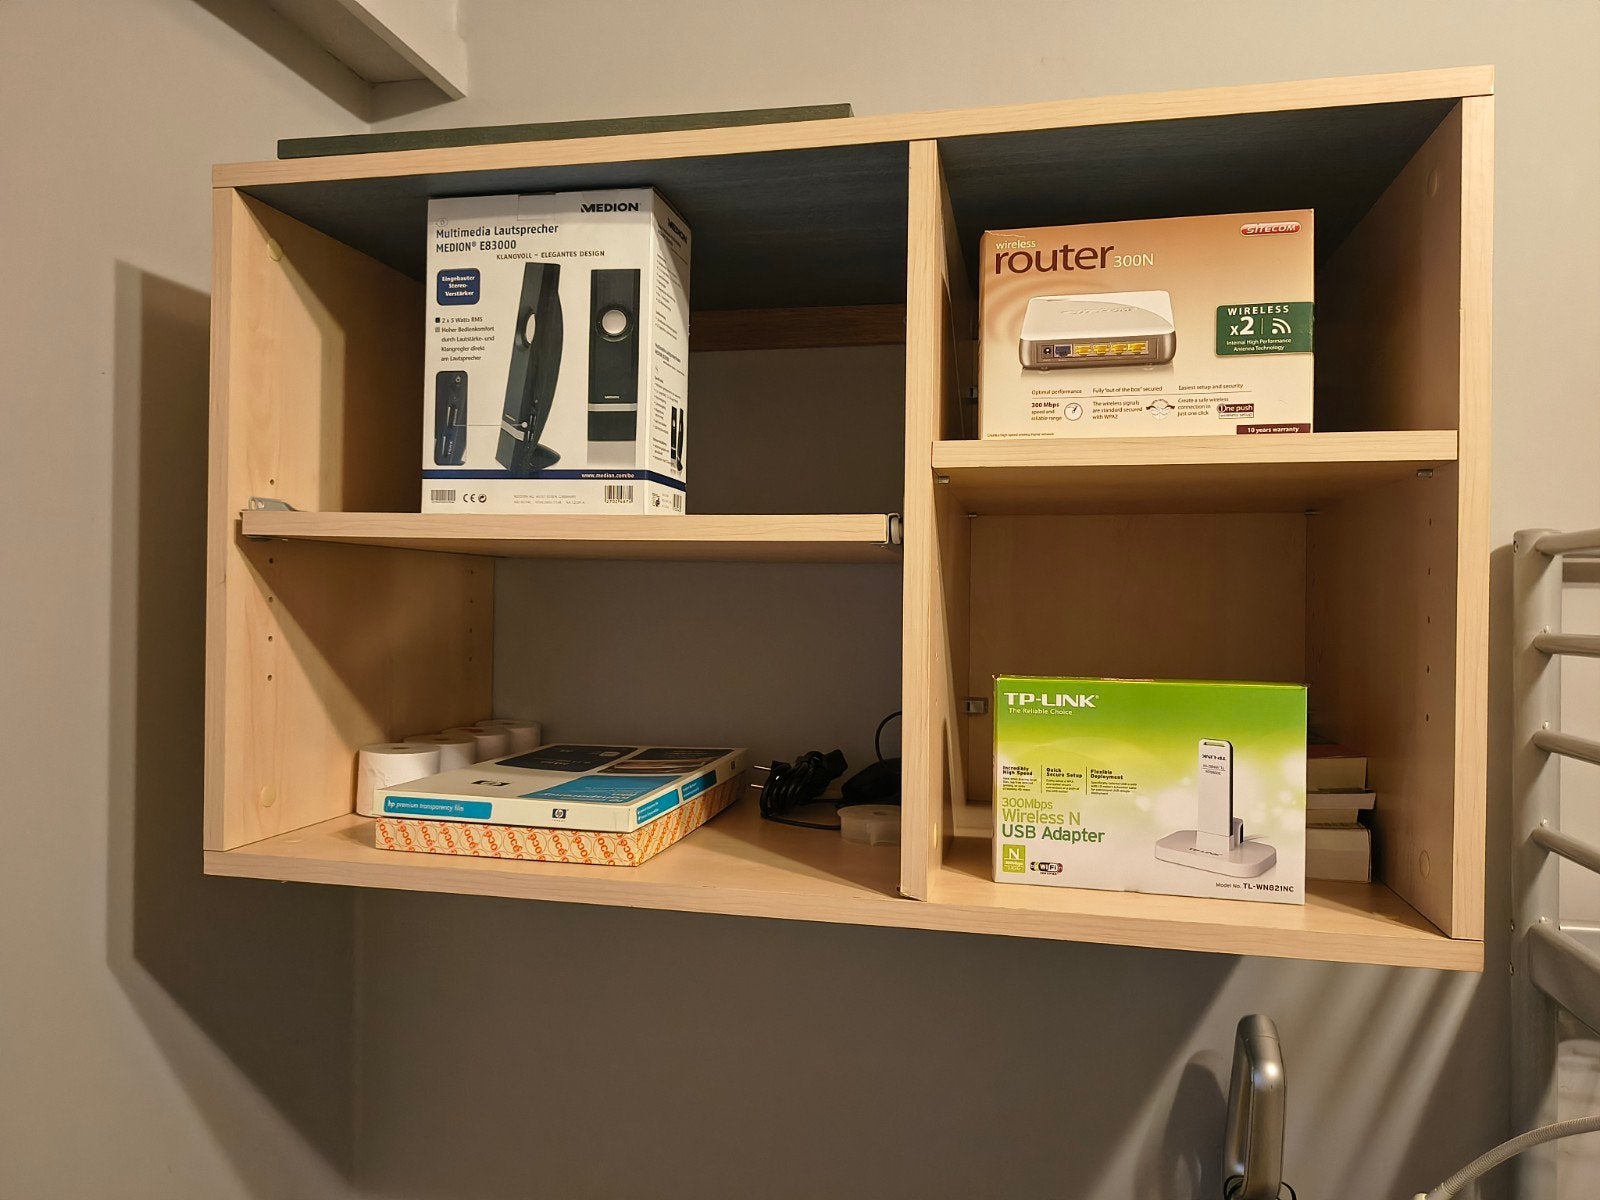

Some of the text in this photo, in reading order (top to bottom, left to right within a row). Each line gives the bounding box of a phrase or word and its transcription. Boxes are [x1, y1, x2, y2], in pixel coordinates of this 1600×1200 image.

[581, 202, 640, 213] MEDION
[436, 224, 559, 239] Multimedia Lautsprecher
[1246, 222, 1297, 234] SITECOM
[480, 240, 517, 251] E83000
[995, 239, 1036, 249] wireless
[496, 252, 533, 260] KLANGVOLL
[541, 250, 578, 258] ELEGANTES
[995, 244, 1154, 275] router 300N
[441, 275, 476, 283] Eingebauter
[1227, 305, 1290, 316] WIRELESS
[1230, 315, 1255, 336] x2
[1049, 708, 1073, 716] Choice
[387, 799, 396, 809] hp
[395, 801, 419, 810] premium
[419, 803, 454, 812] transparency
[1002, 797, 1053, 811] 300Mbps
[1002, 808, 1081, 826] Wireless N
[1002, 823, 1106, 845] USB Adapter
[1008, 847, 1020, 860] N
[1242, 883, 1295, 893] TL-WN821NC
